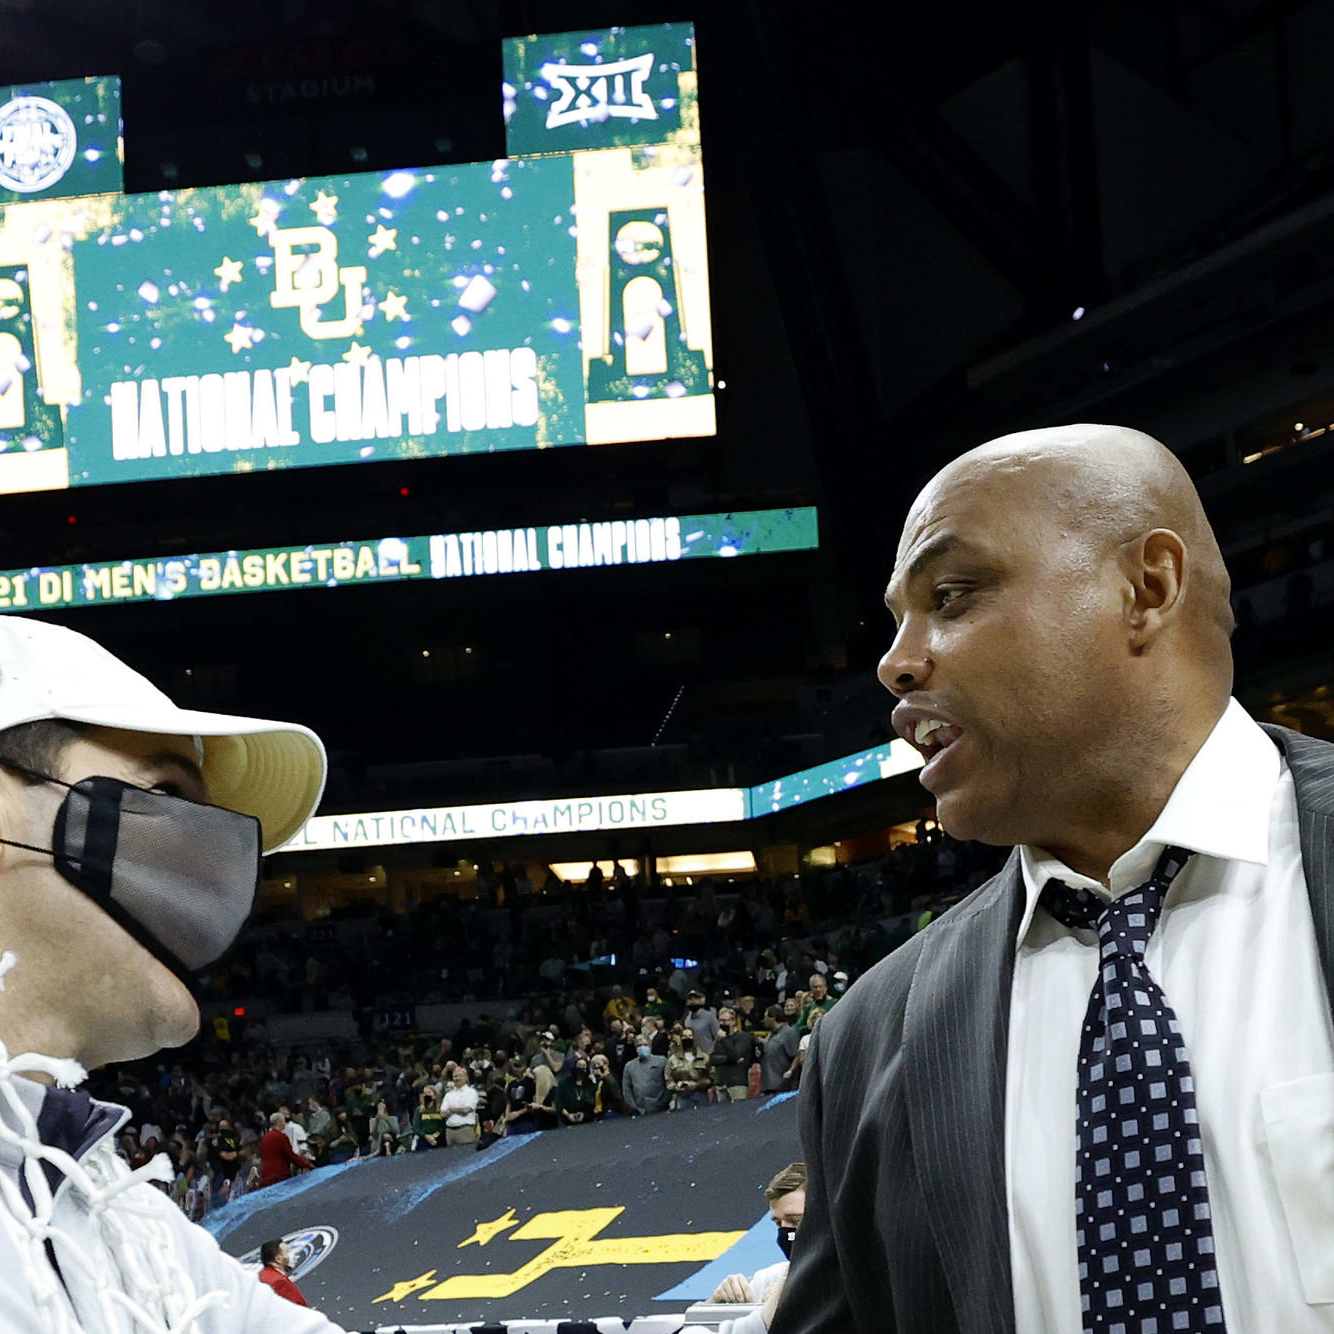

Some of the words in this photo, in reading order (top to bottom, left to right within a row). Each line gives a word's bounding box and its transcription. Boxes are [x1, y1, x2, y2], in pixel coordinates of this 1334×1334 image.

[246, 74, 376, 104] STADIUM
[110, 368, 300, 461] NATIONAL
[308, 347, 539, 443] CHAMPIONS
[85, 560, 187, 601] MEN'S
[199, 543, 421, 591] BASKETBALL
[430, 528, 541, 578] NATIONAL
[547, 517, 681, 569] CHAMPIONS
[333, 811, 476, 842] NATIONAL
[491, 798, 668, 833] CHAMPIONS
